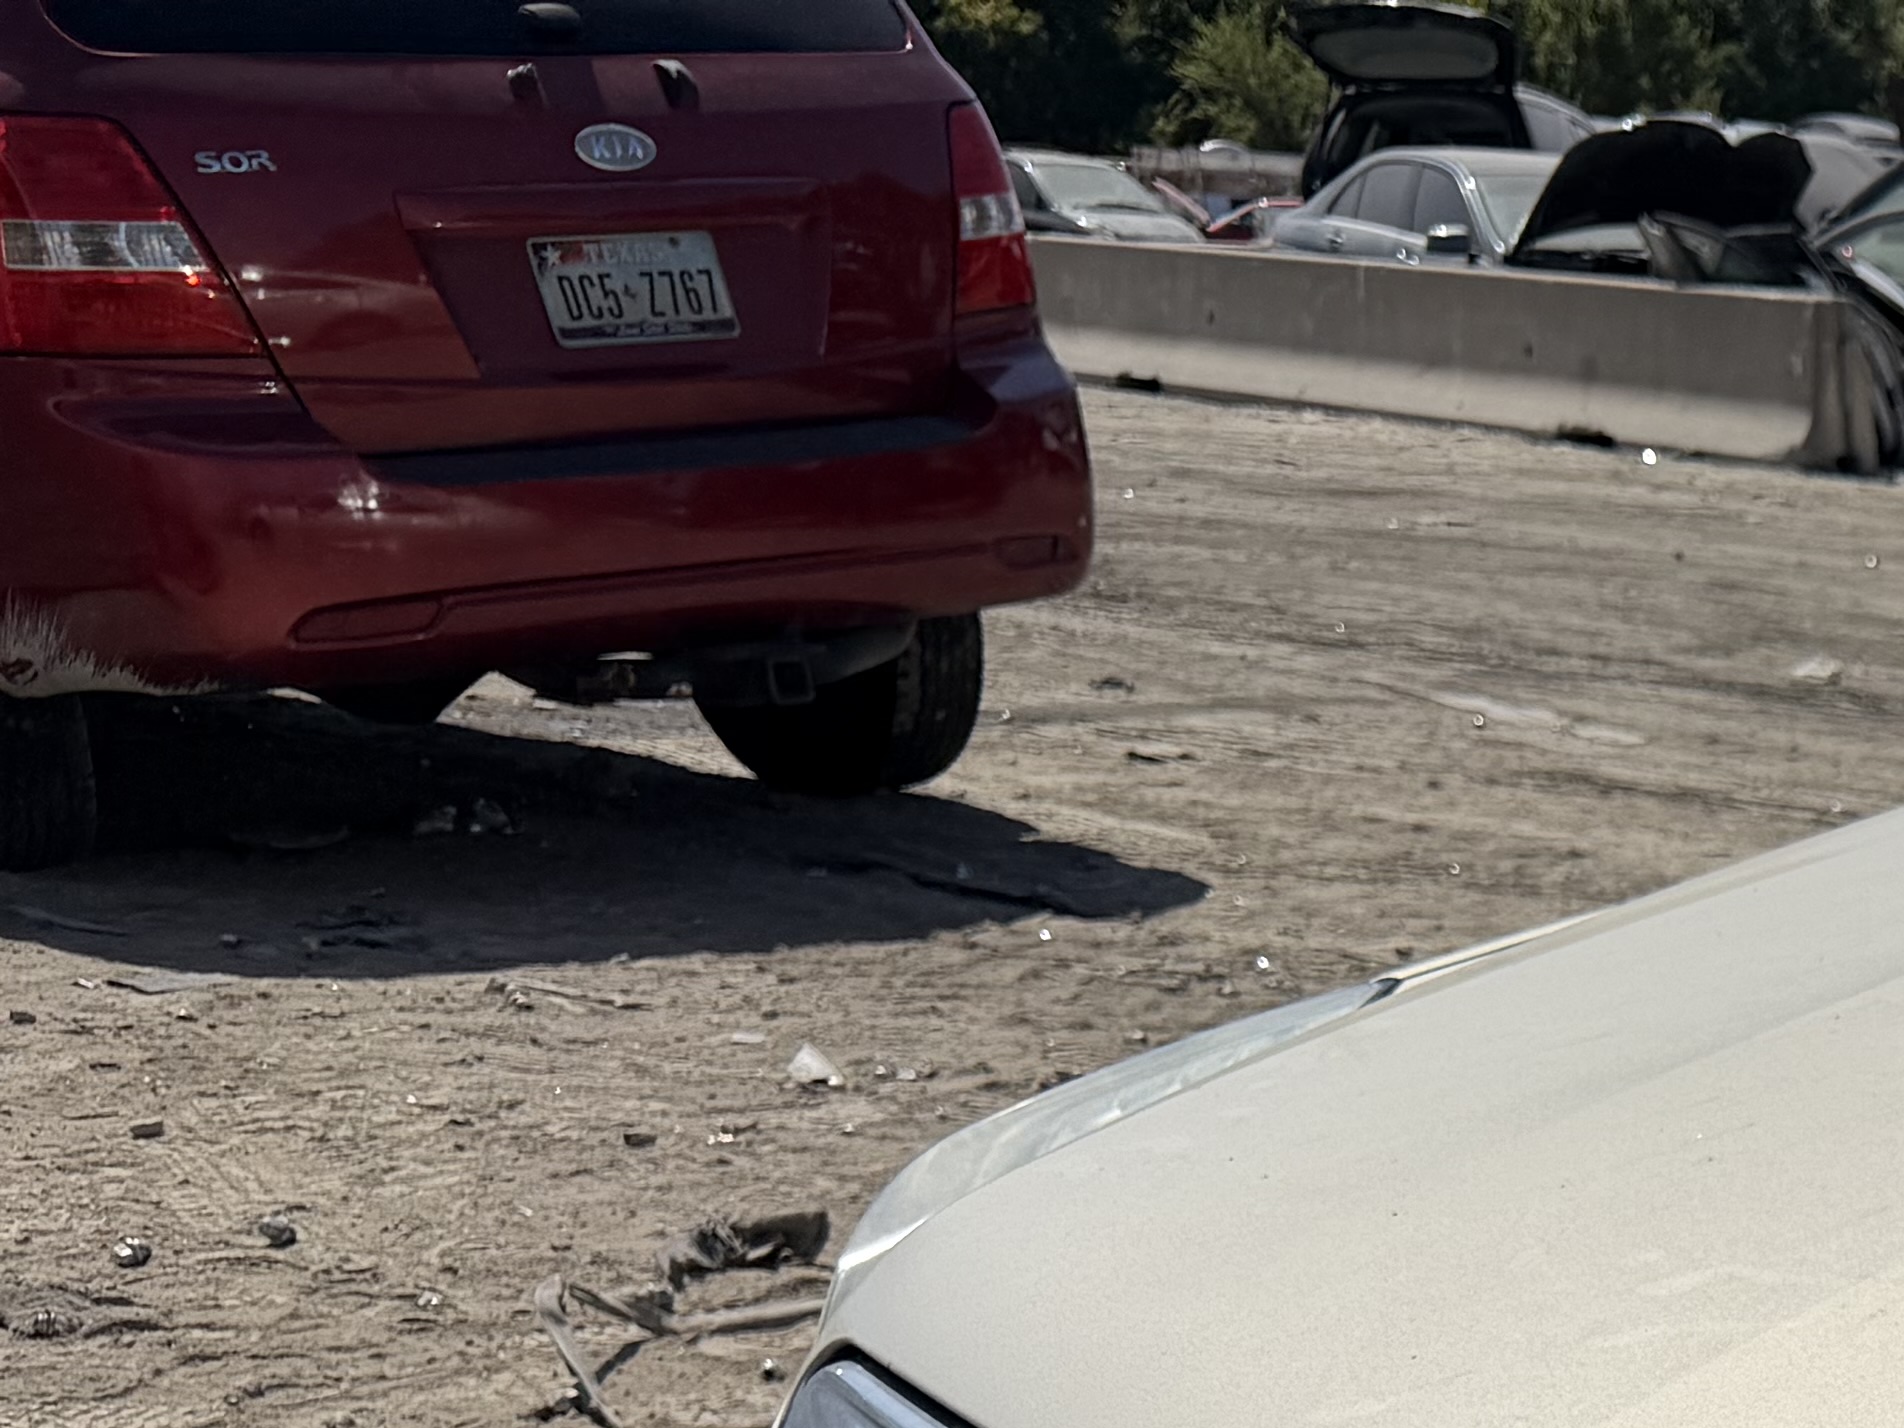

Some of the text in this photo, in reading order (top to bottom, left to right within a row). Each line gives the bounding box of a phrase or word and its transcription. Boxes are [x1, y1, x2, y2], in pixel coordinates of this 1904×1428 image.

[591, 135, 644, 159] KIA
[194, 150, 277, 173] SOR
[583, 242, 669, 265] TEXAS
